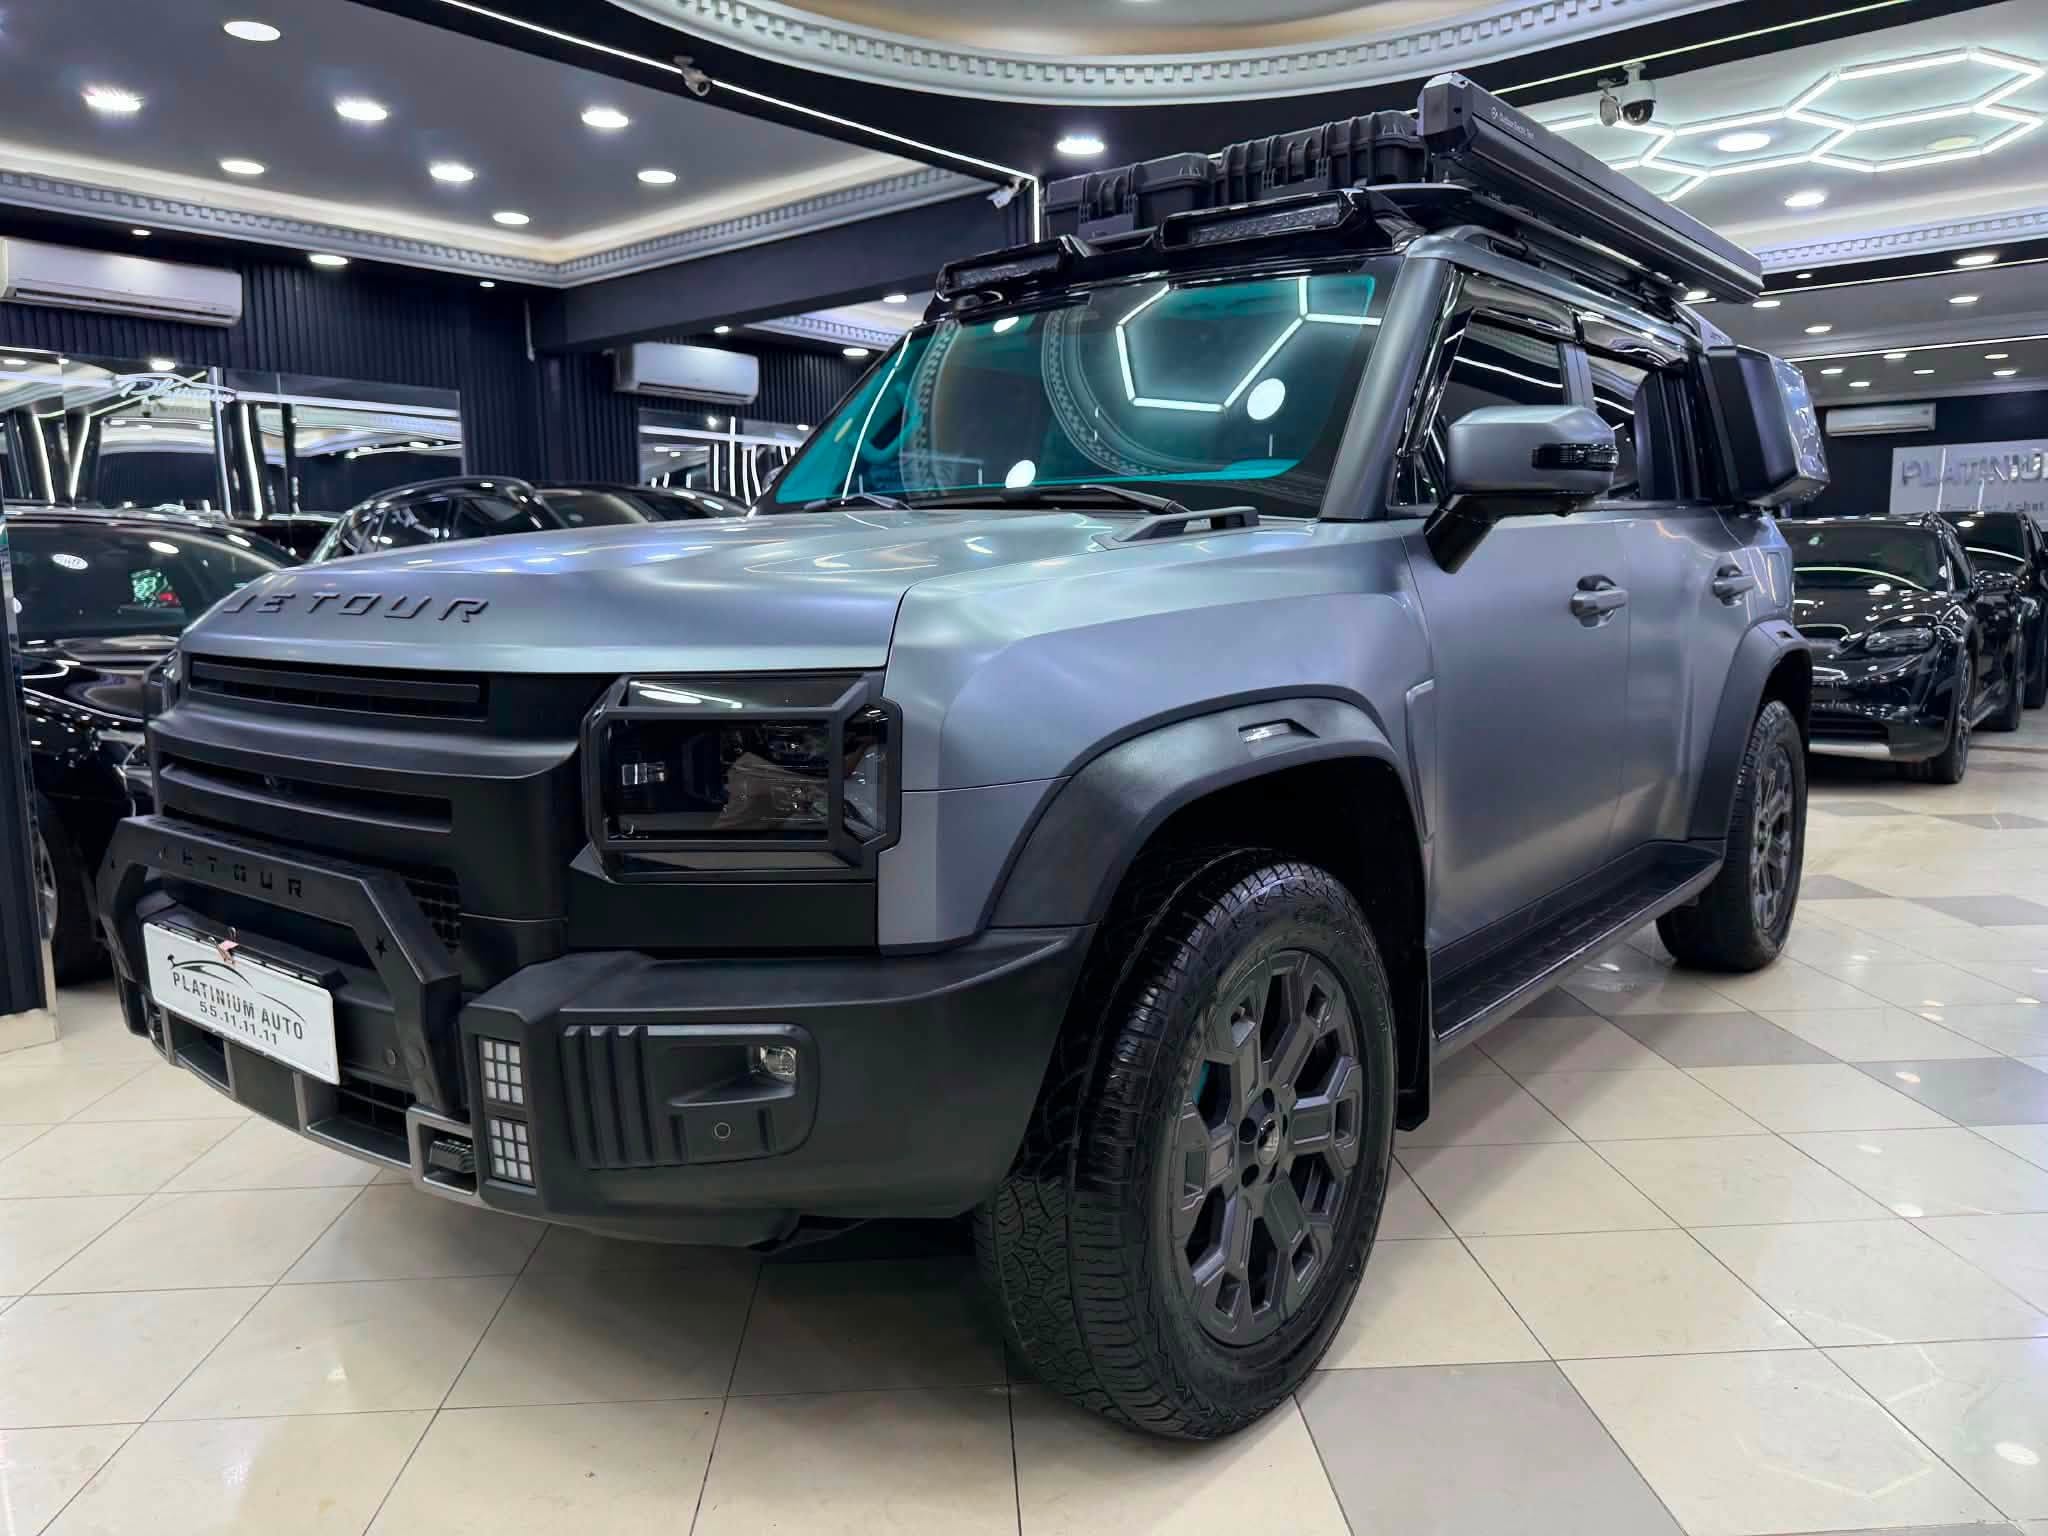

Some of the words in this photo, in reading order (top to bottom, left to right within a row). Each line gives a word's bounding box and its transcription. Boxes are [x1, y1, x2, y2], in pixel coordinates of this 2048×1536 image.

[223, 592, 489, 623] JETOUR
[172, 972, 255, 1019] PLATINIUM
[261, 1008, 303, 1040] AUTO
[200, 1001, 277, 1045] 55.11.11.11
